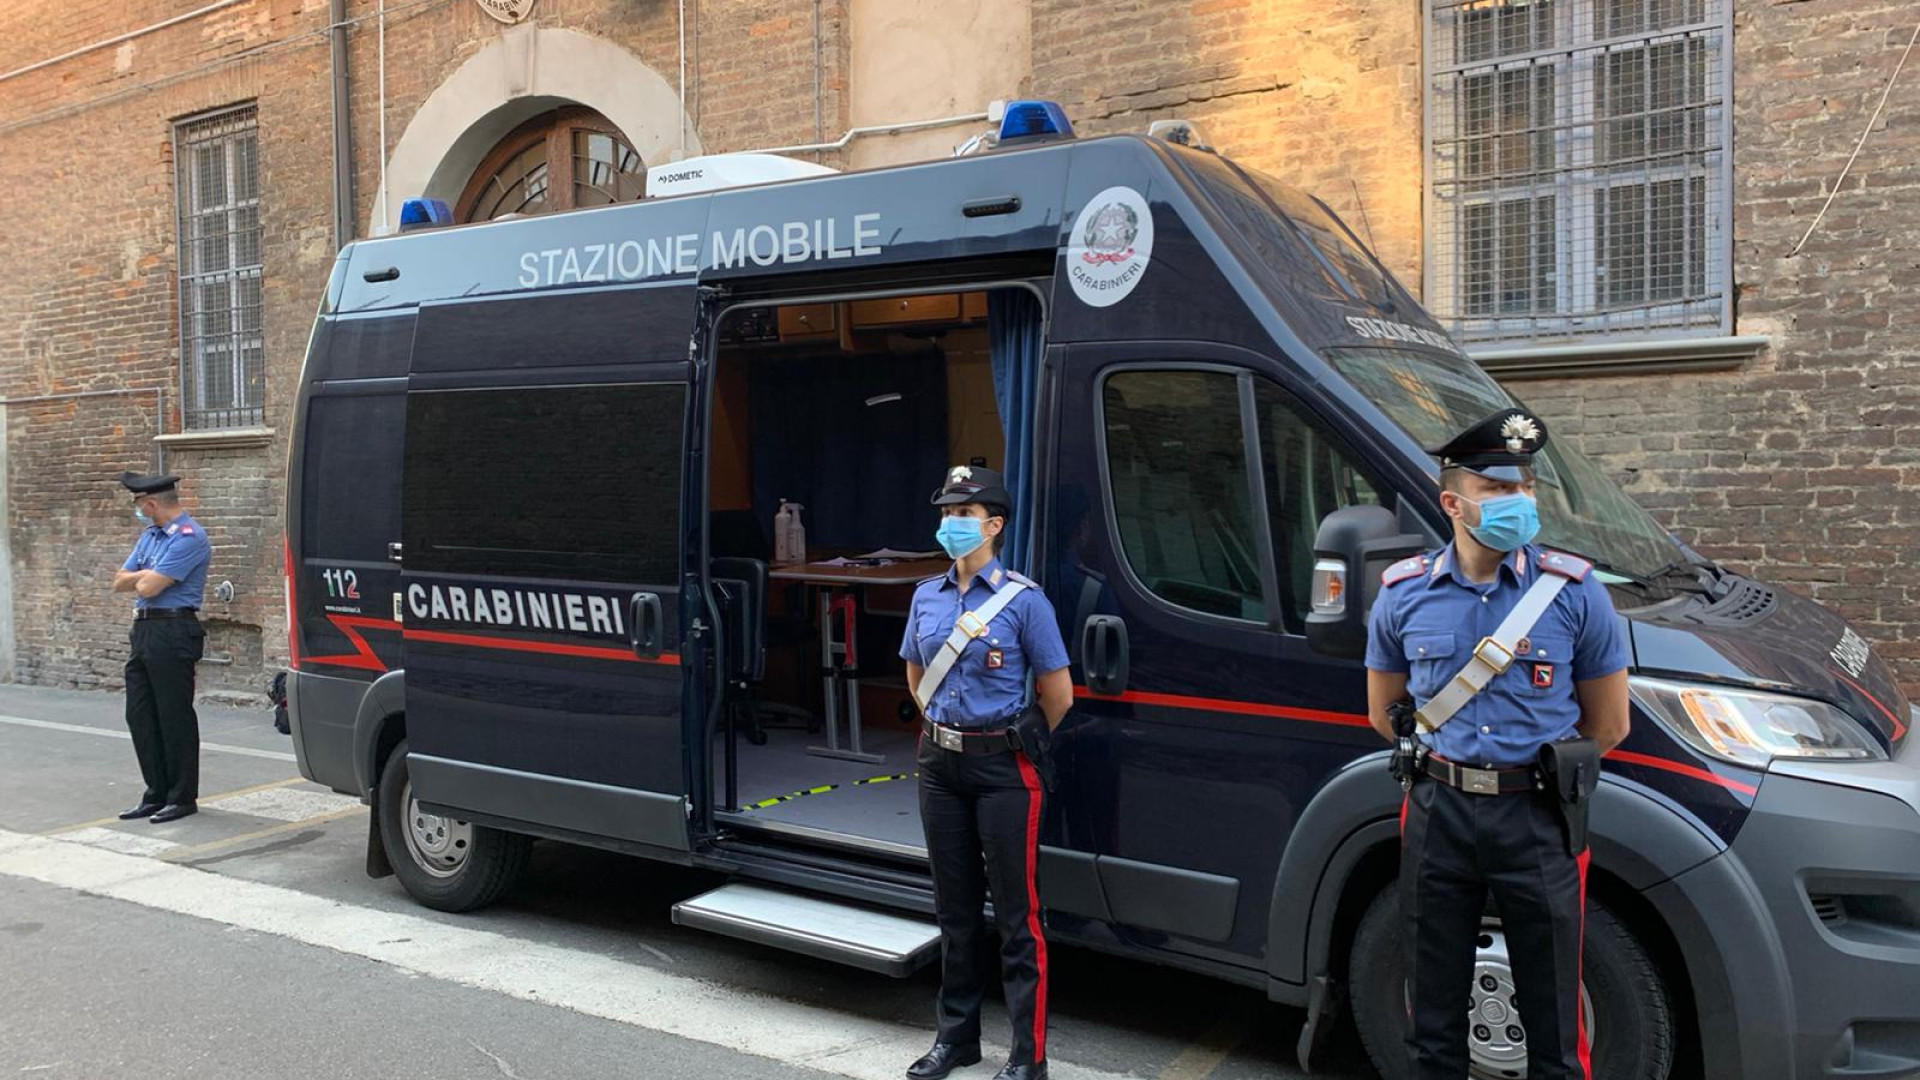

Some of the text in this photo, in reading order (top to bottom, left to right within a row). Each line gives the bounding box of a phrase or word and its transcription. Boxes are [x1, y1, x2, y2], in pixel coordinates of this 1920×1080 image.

[667, 169, 703, 183] DOMETIC
[518, 213, 882, 289] STAZIONE MOBILE
[1072, 262, 1142, 291] CARABINIERI
[322, 568, 361, 599] 112
[408, 582, 625, 635] CARABINIERI
